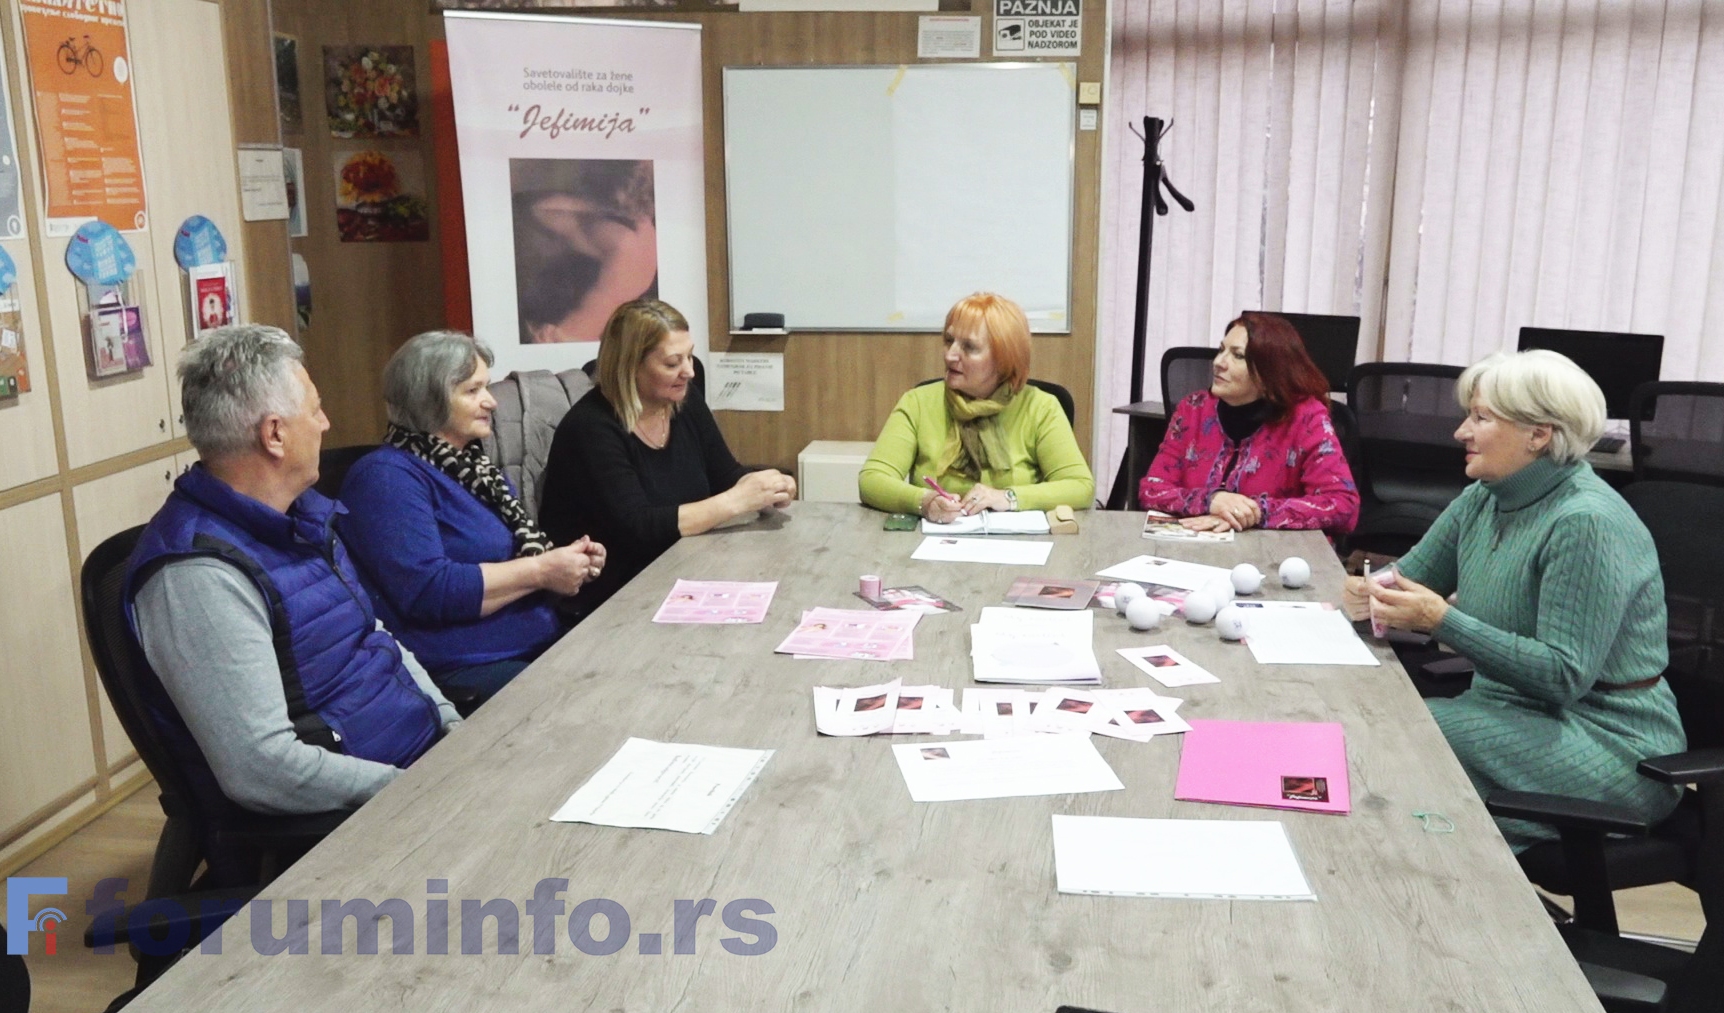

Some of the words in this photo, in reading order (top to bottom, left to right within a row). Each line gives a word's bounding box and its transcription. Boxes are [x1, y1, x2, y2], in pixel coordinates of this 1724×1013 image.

[1028, 19, 1066, 28] OBJEKAT
[1068, 19, 1079, 28] JE
[1029, 30, 1048, 39] POD
[1050, 30, 1077, 39] VIDEO
[1027, 40, 1078, 49] NADZOROM
[523, 67, 593, 80] Savetovalište
[596, 73, 607, 81] za
[610, 70, 633, 81] žene
[523, 80, 562, 92] obolele
[565, 81, 579, 92] od
[581, 82, 604, 93] raka
[606, 83, 634, 96] dojke
